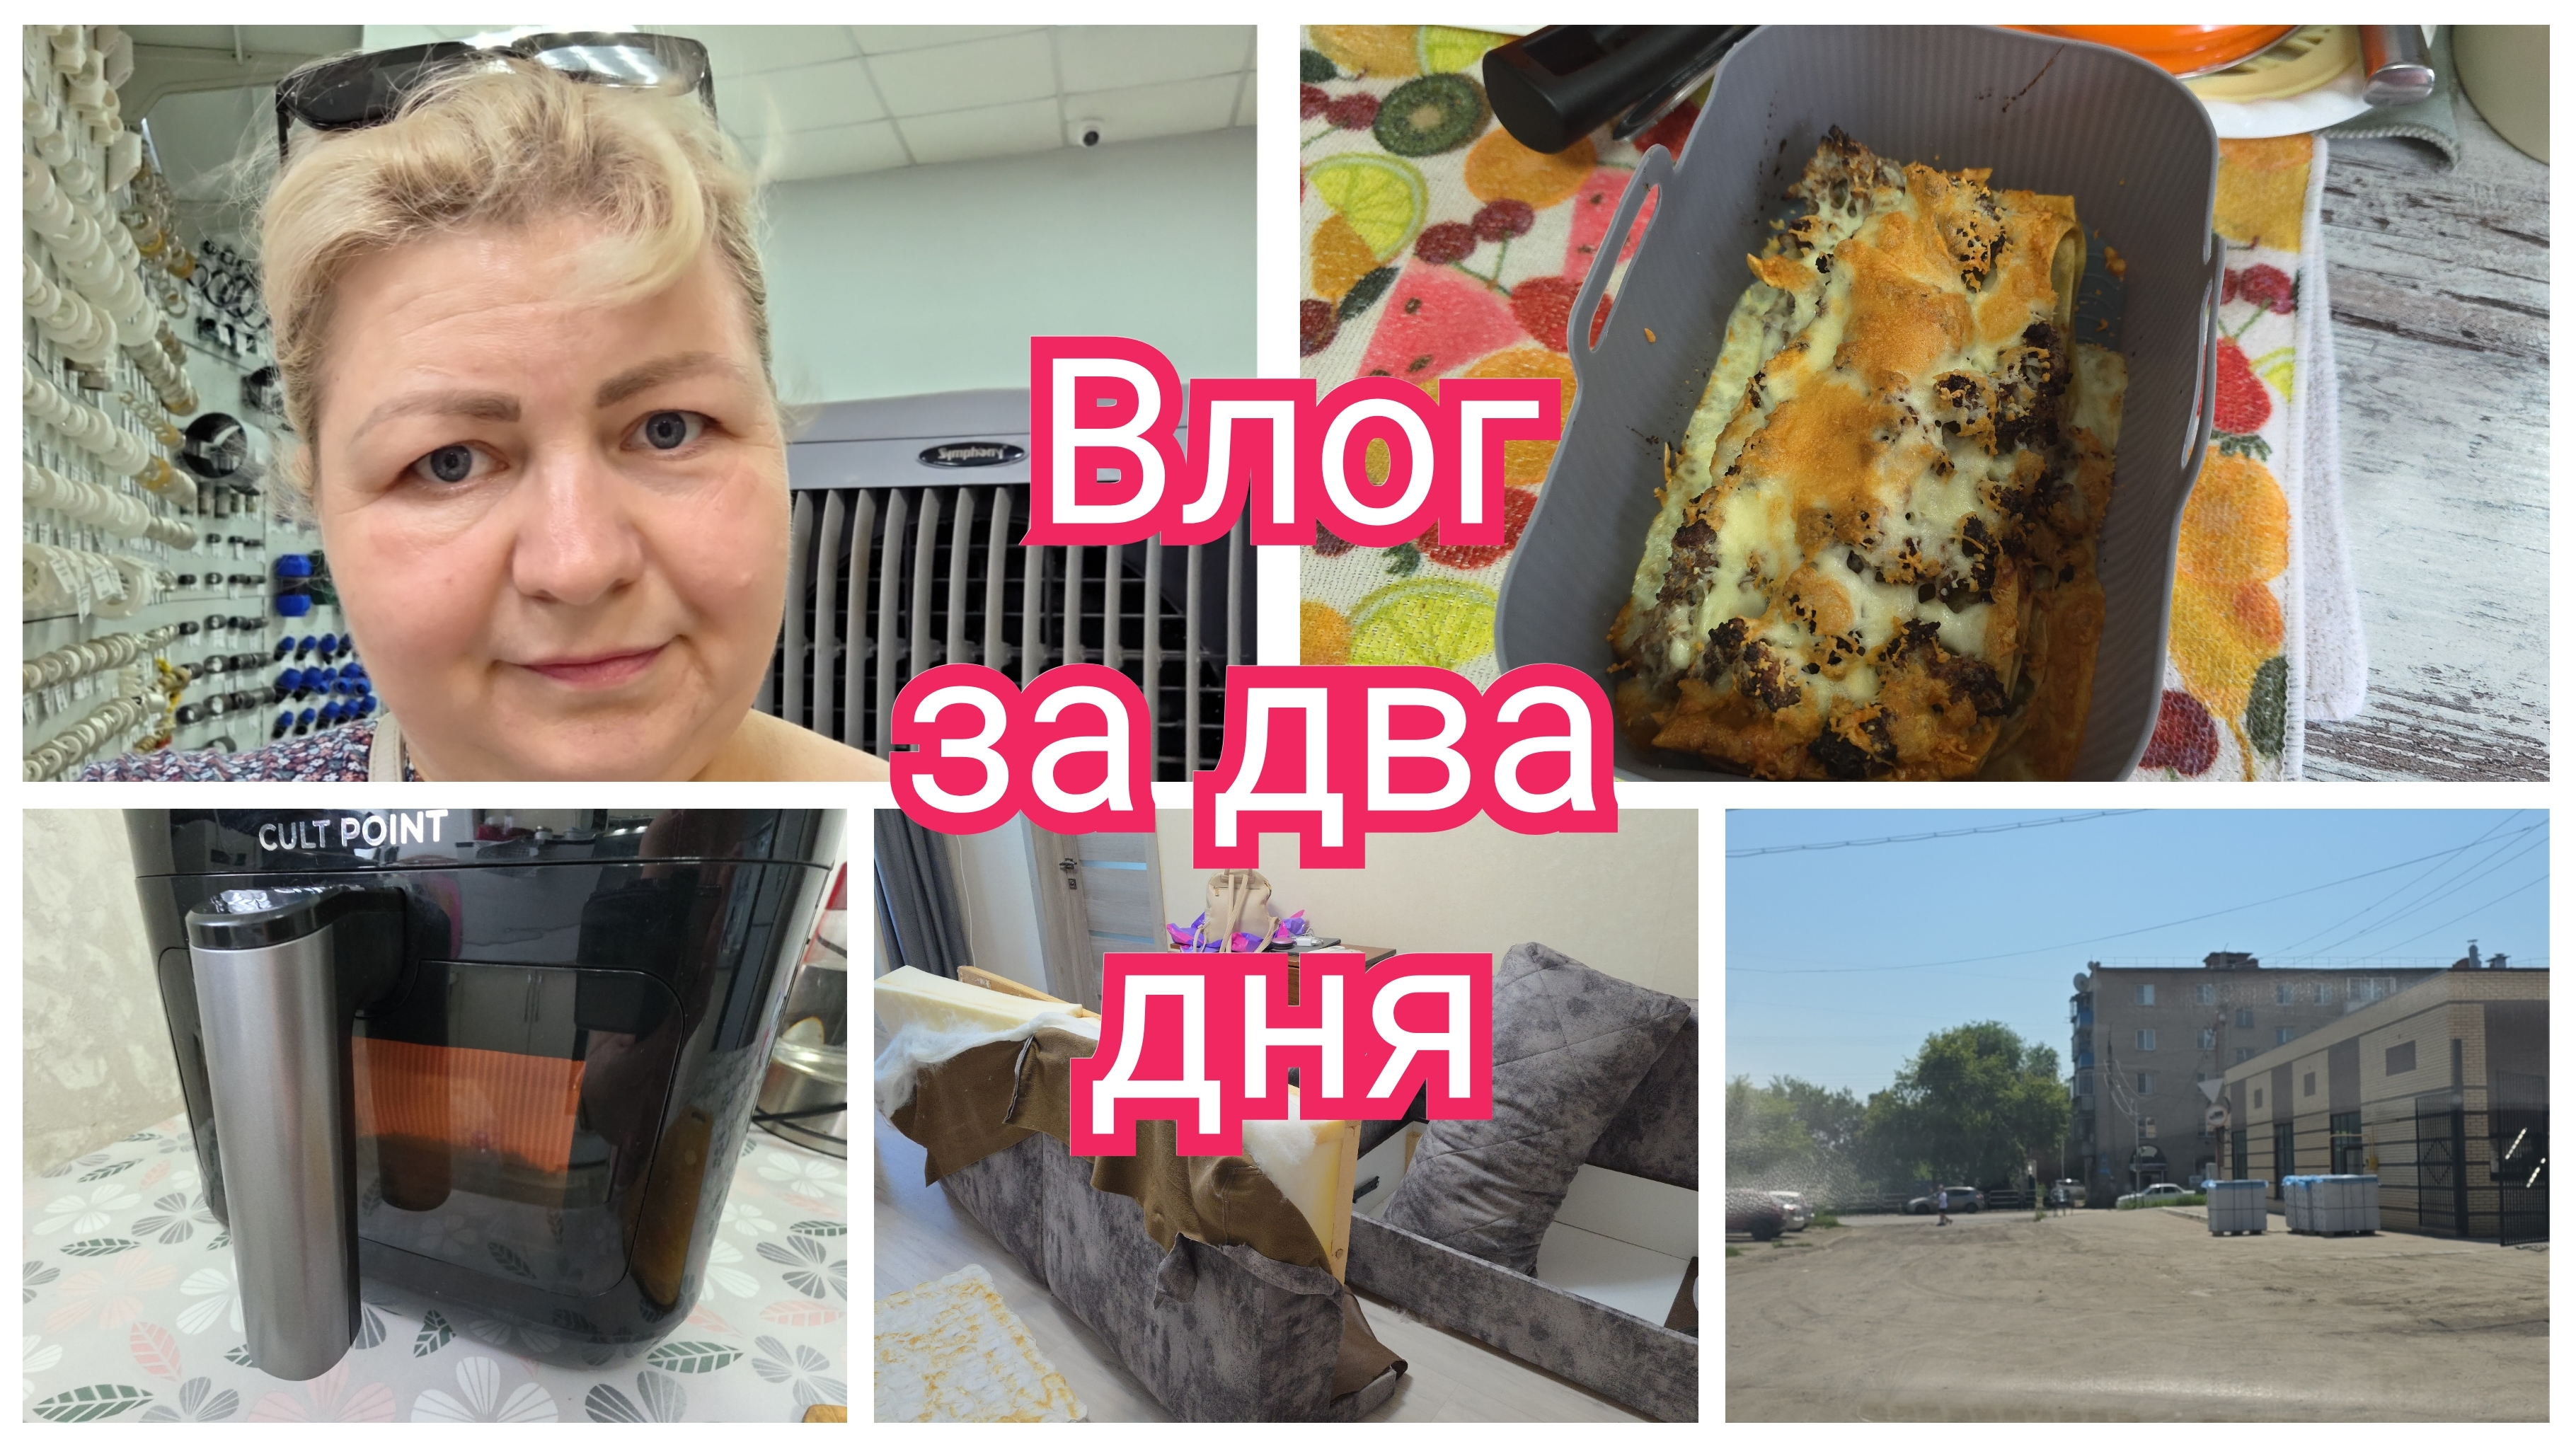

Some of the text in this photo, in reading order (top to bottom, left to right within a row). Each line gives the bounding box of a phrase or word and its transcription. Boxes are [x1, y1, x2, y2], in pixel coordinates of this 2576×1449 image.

[938, 446, 1004, 460] Symphony
[258, 809, 449, 851] CULT POINT
